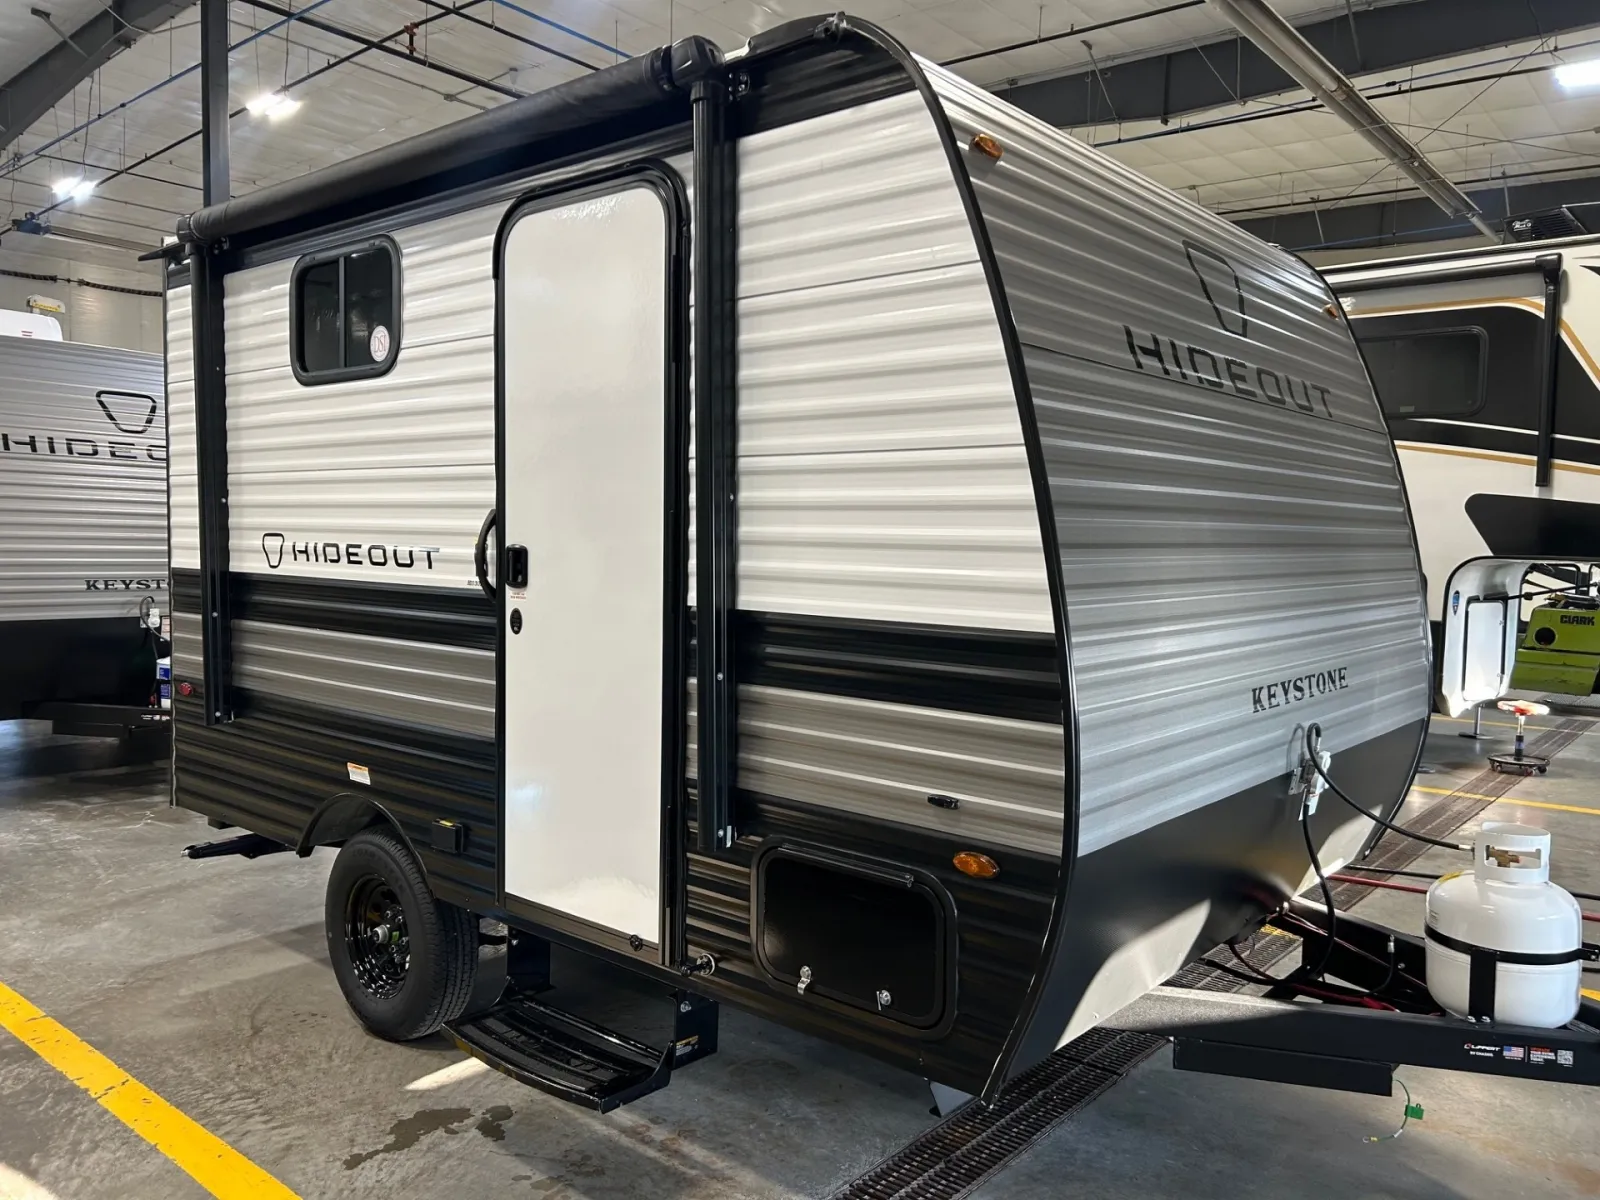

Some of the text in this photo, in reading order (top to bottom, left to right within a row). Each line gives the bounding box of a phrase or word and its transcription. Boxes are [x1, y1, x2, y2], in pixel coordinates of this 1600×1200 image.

[1122, 324, 1333, 418] HIDEOUT
[292, 541, 440, 570] HIDEOUT
[84, 579, 169, 591] KEYST
[1560, 614, 1596, 626] CLARK
[1251, 666, 1349, 714] KEYSTONE
